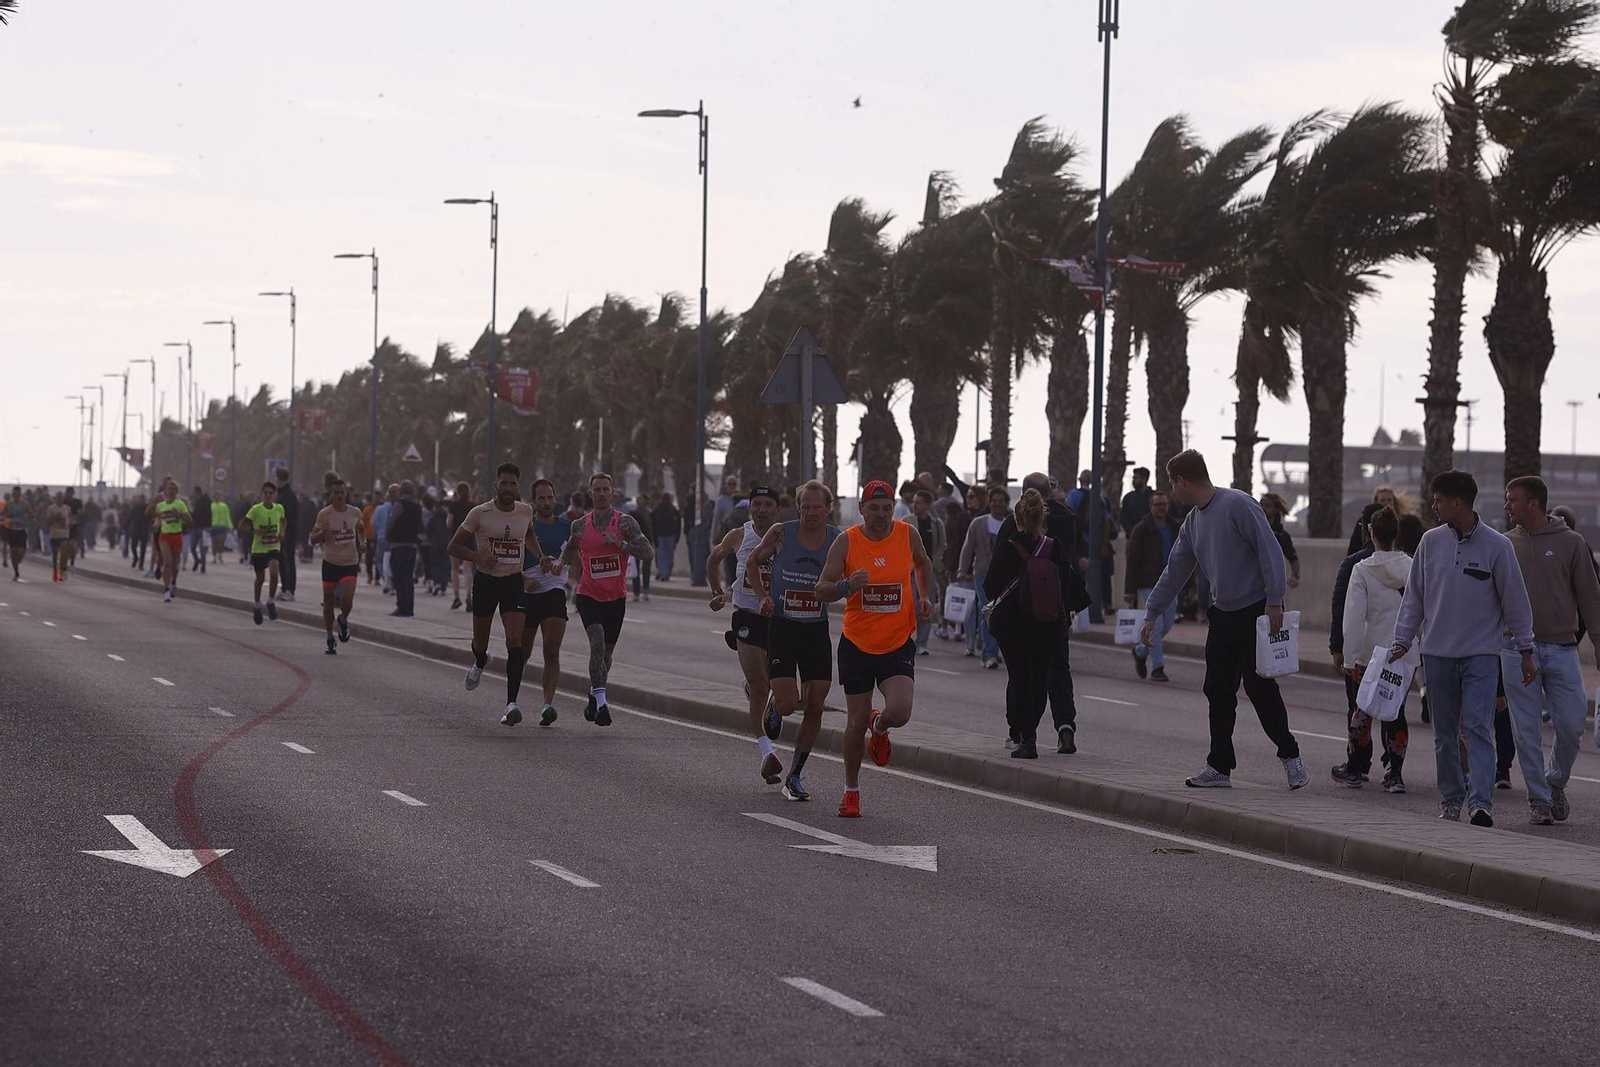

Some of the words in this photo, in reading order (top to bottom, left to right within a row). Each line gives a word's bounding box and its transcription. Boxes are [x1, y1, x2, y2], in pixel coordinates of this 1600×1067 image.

[883, 593, 898, 602] 290
[805, 600, 819, 608] 718
[1380, 667, 1403, 687] 26ERS
